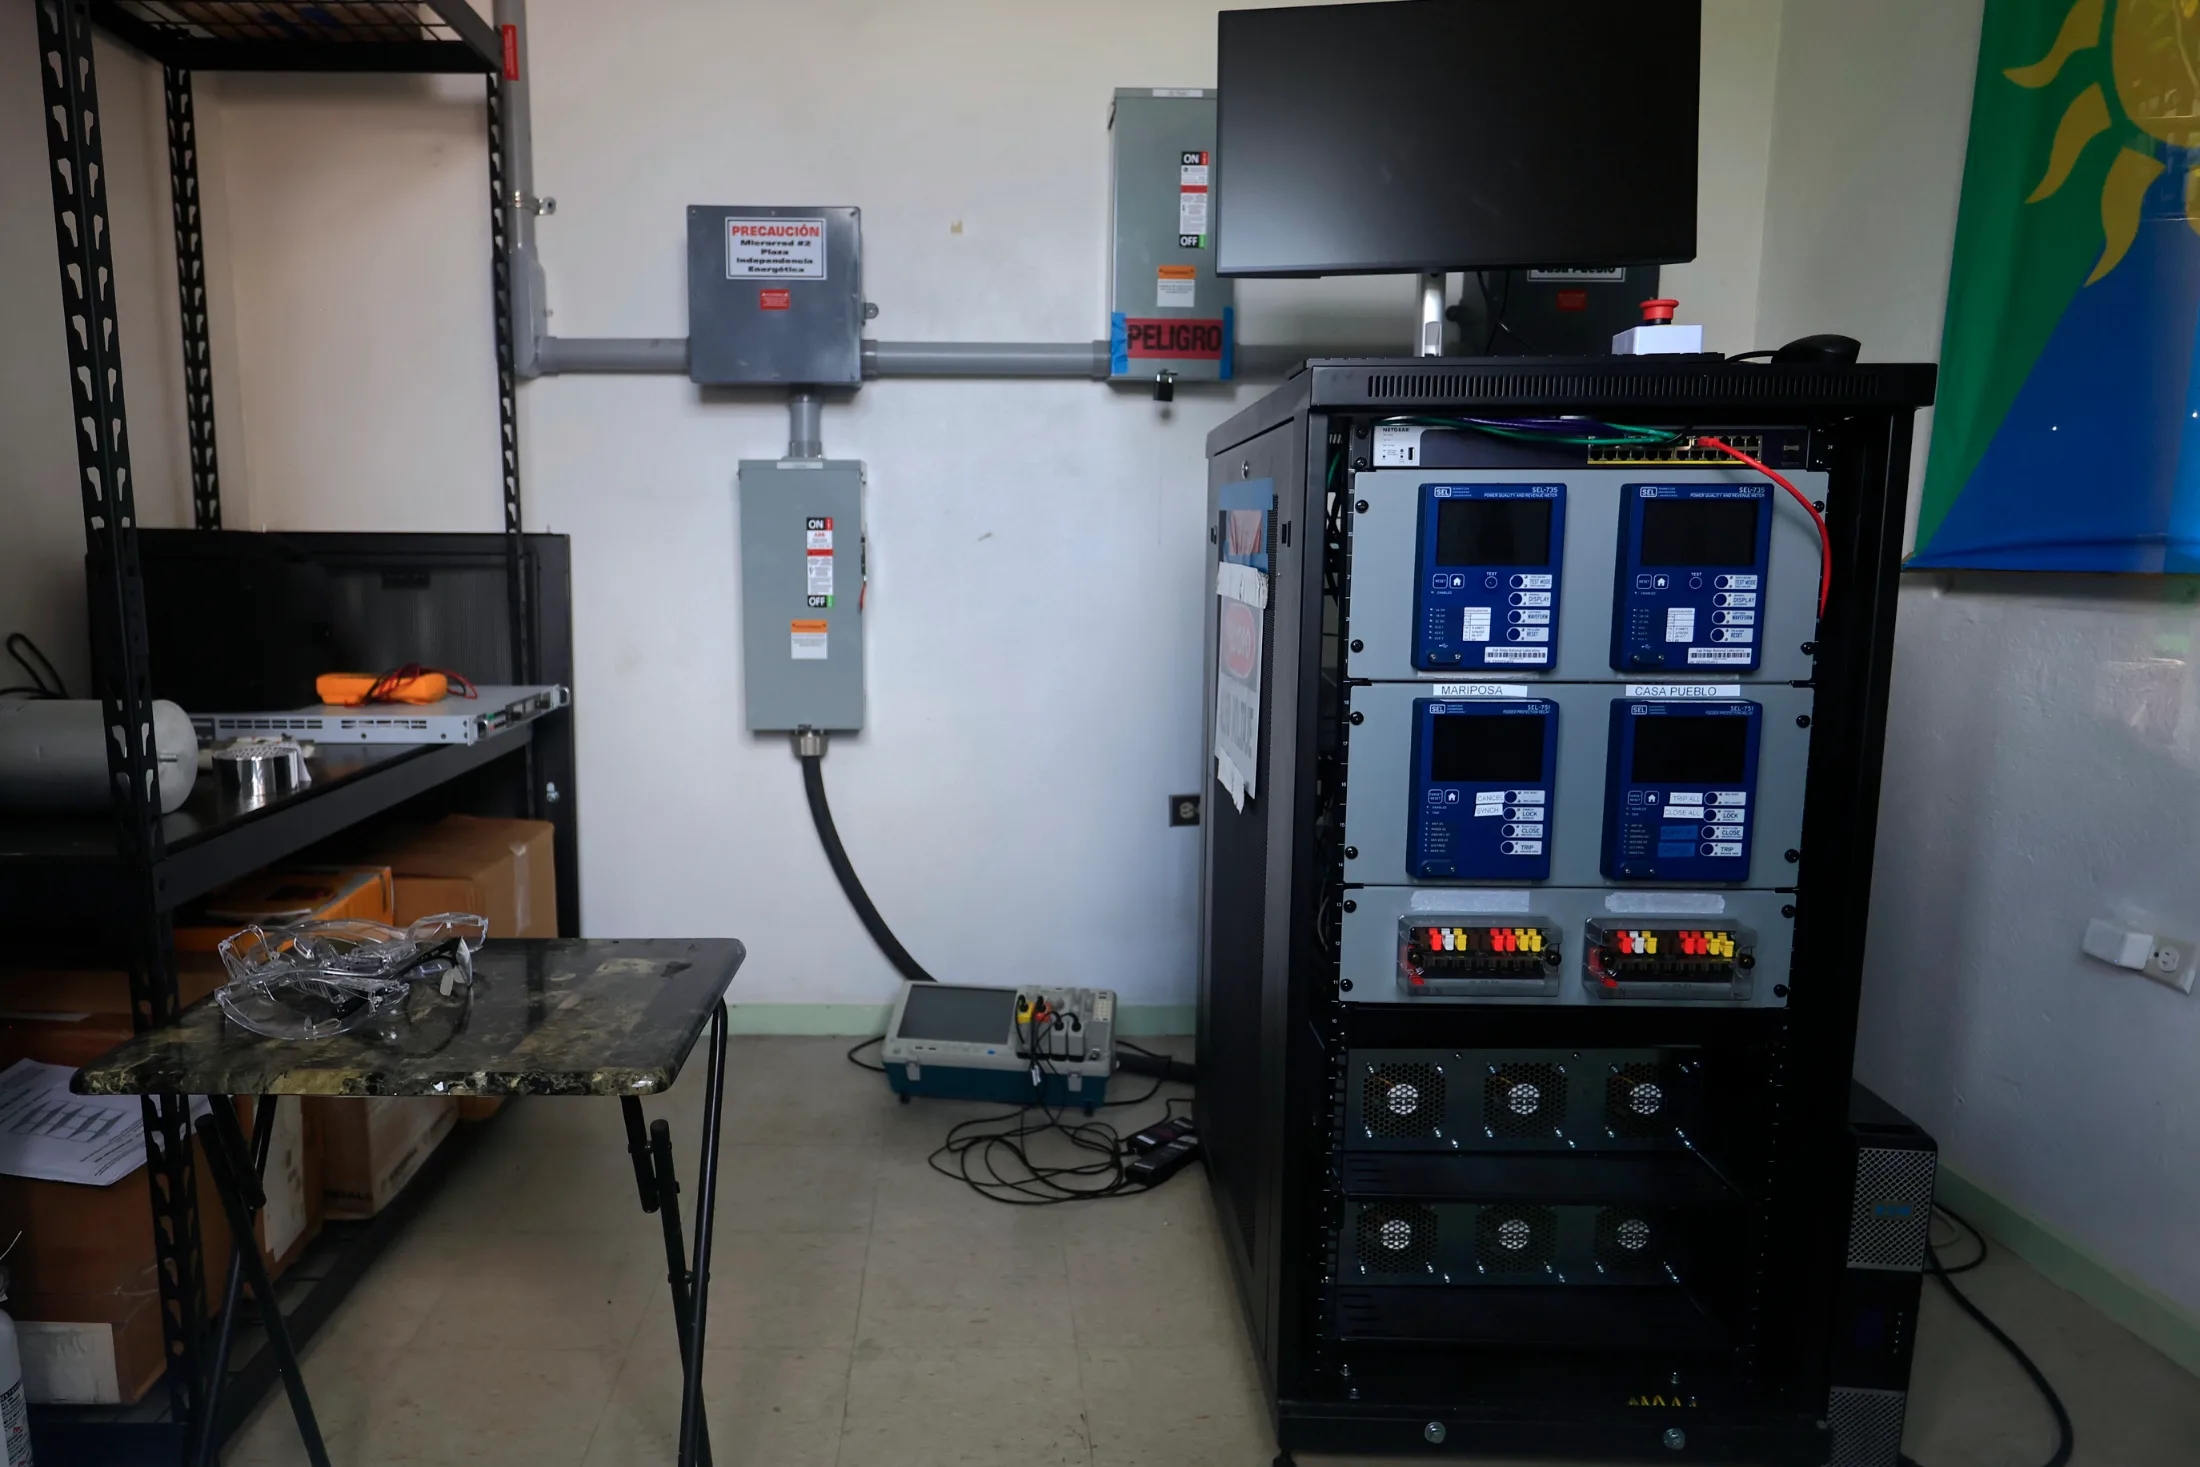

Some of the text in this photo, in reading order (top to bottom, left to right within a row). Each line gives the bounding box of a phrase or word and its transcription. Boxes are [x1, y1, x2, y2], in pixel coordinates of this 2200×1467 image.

[1183, 154, 1200, 164] ON
[732, 224, 819, 237] PRECAUCIÓN
[1180, 236, 1198, 246] OFF
[1127, 324, 1222, 352] PELIGRO
[808, 520, 824, 529] ON
[808, 597, 825, 606] OFF
[1441, 685, 1503, 695] MARIPOSA
[1635, 686, 1717, 696] CASA PUEBLO
